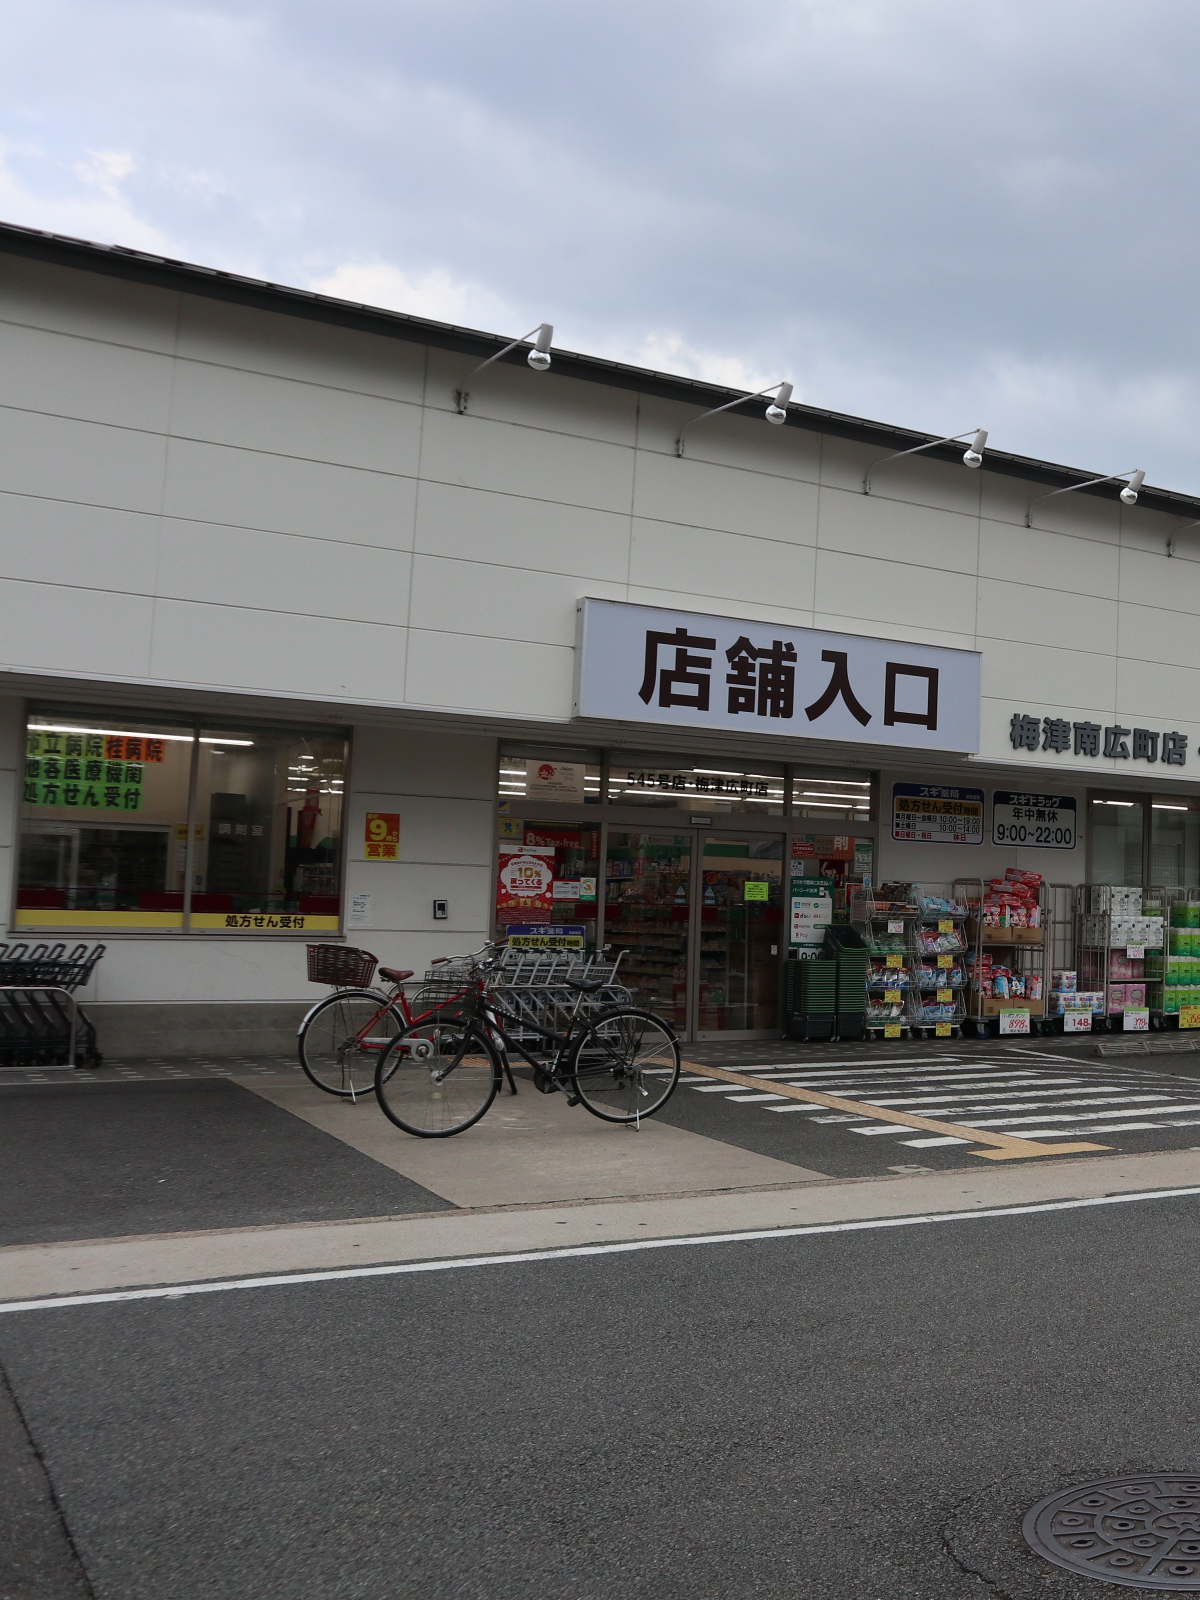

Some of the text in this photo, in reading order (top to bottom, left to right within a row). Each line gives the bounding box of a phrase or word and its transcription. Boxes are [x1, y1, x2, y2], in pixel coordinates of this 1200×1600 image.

[638, 627, 939, 731] 店舗入口
[919, 787, 960, 798] スギ薬局
[1009, 794, 1062, 807] スギドラッグ
[898, 799, 979, 815] 処方せん受付時間
[1012, 807, 1058, 823] 年中無休
[367, 843, 397, 857] 営業
[518, 867, 542, 878] 10%
[510, 878, 543, 886] 戻ってくる
[225, 914, 305, 928] 処方せん受付
[529, 927, 564, 935] スギ薬局
[1008, 1018, 1026, 1029] 898
[1072, 1018, 1089, 1027] 148
